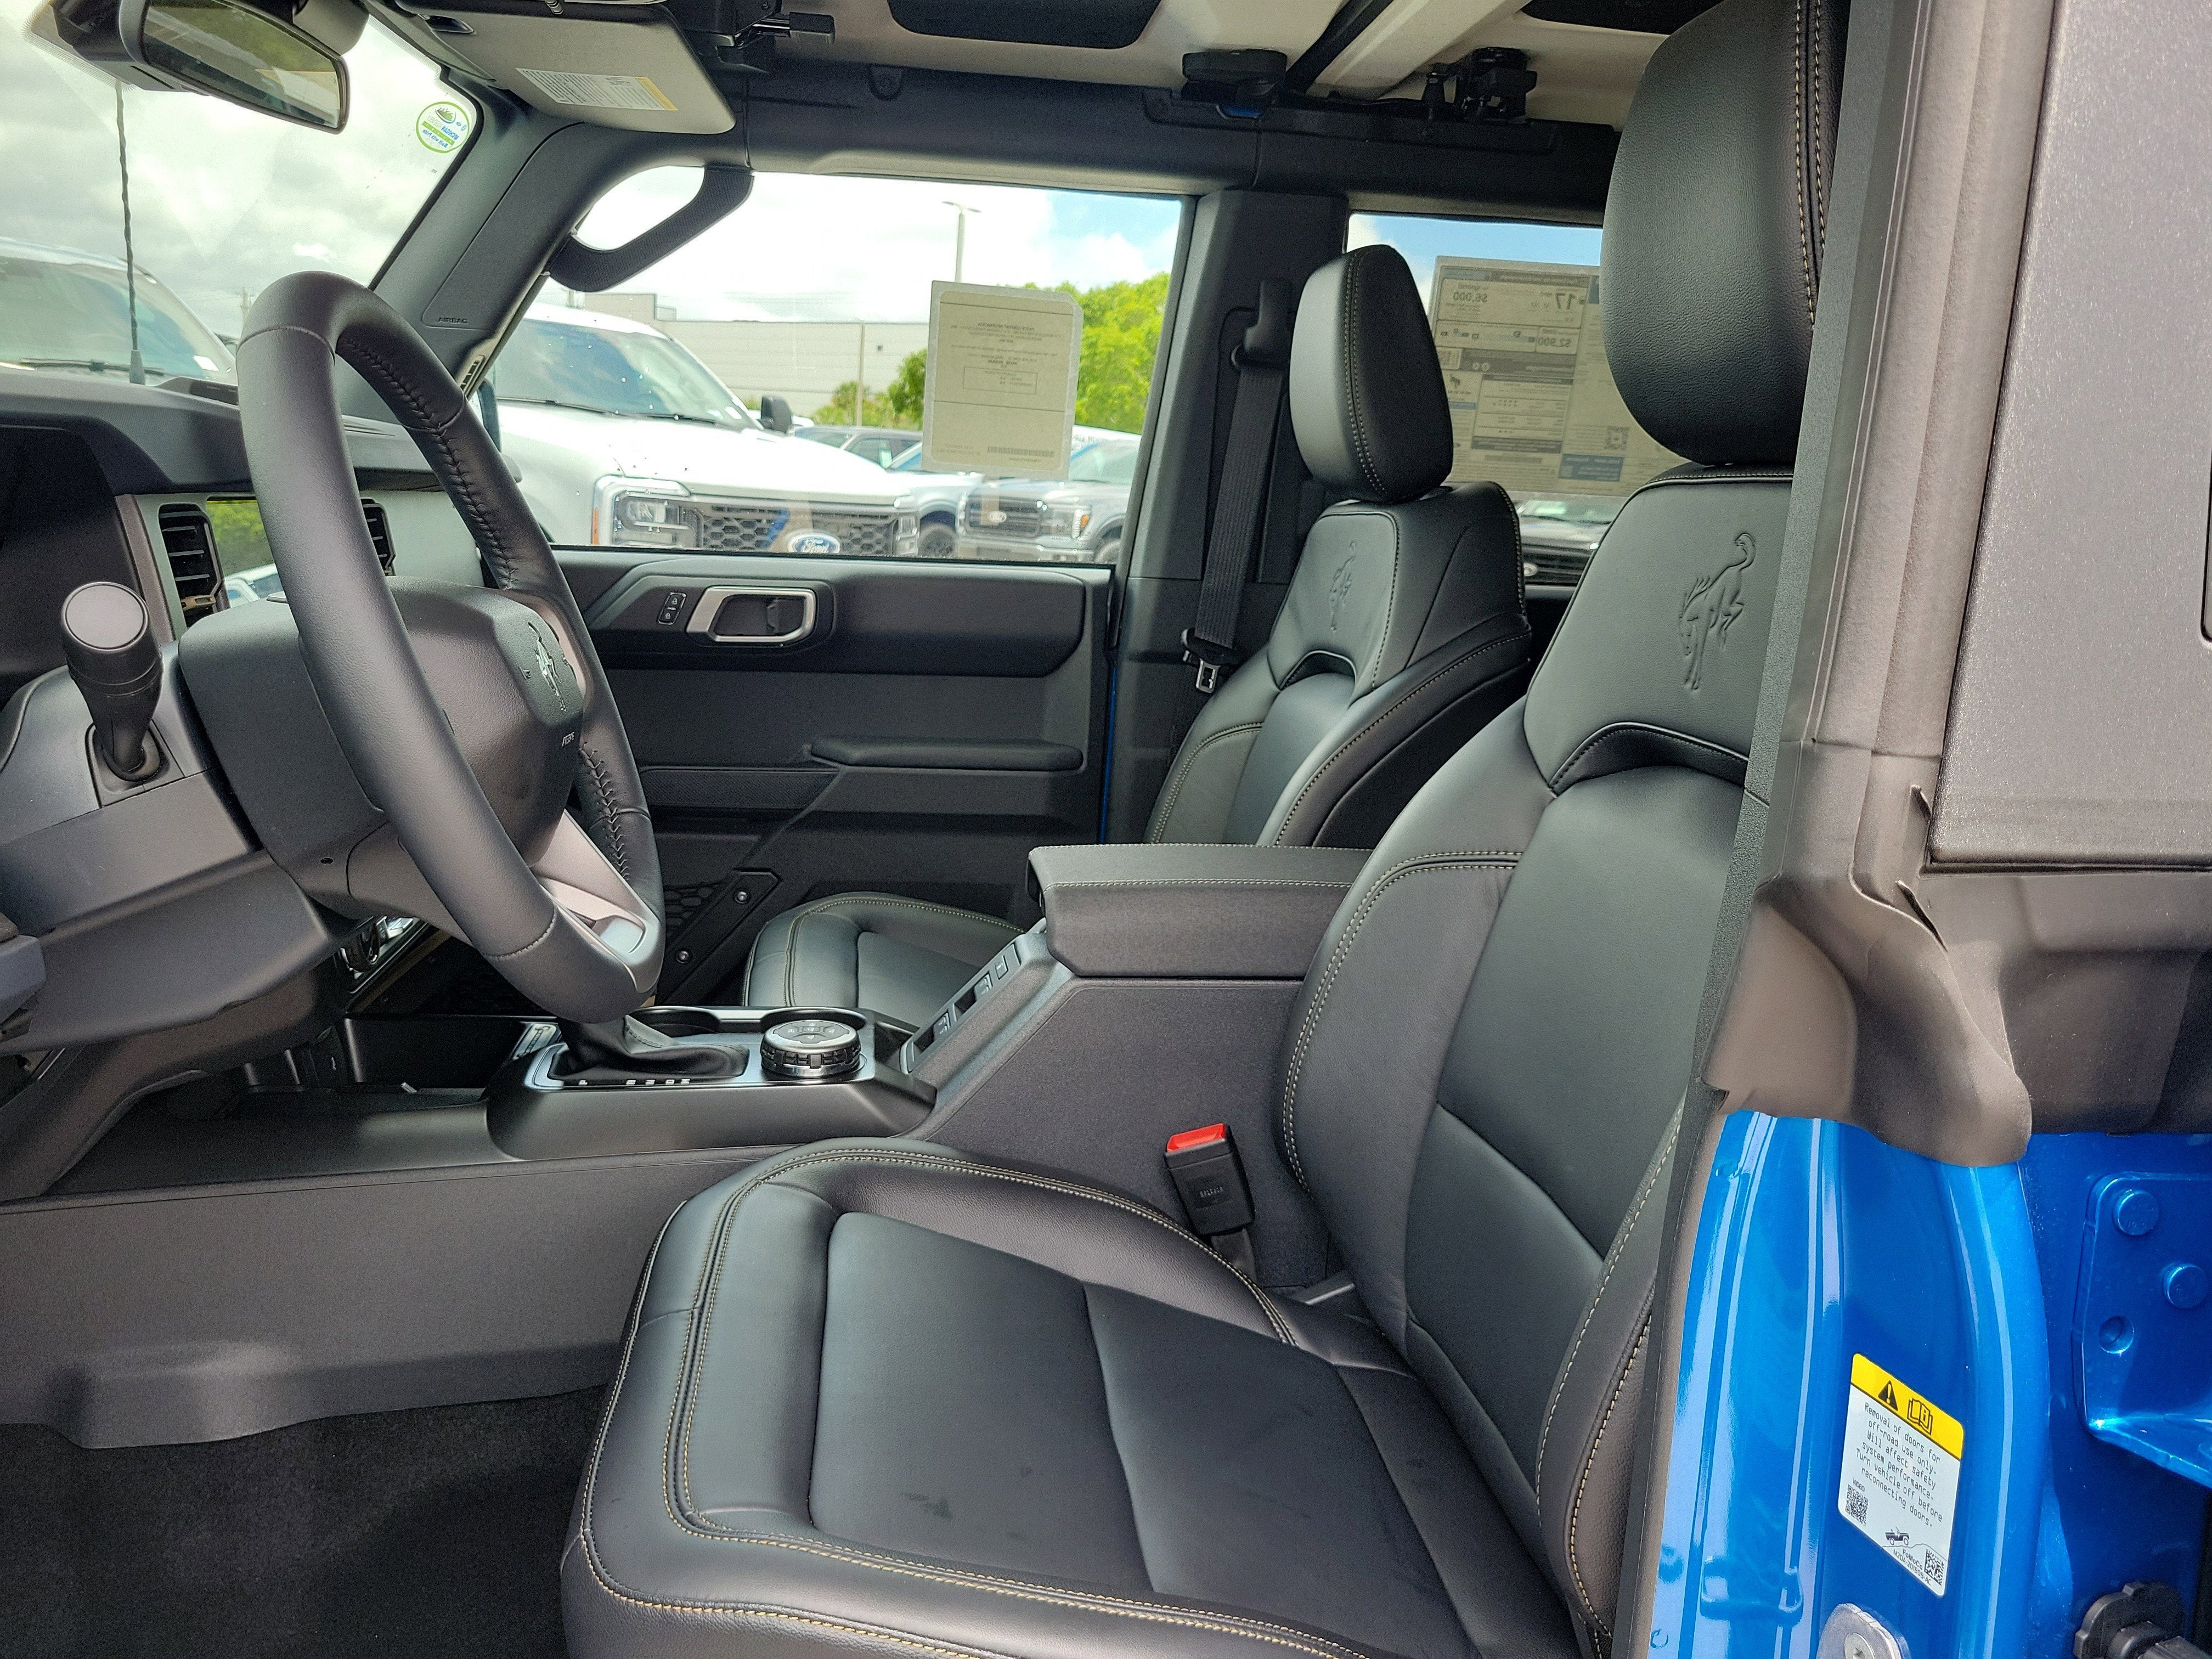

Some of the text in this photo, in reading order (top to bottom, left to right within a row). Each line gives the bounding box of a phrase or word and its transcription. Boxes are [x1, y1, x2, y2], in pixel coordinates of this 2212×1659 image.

[1865, 1402, 1940, 1464] Removal of doors for
[1867, 1430, 1936, 1490] Will affect safety
[1869, 1420, 1937, 1475] off-road use only.
[1852, 1478, 1865, 1492] VIDEO
[1857, 1448, 1943, 1522] Turn vehicle off before
[1861, 1468, 1932, 1527] reconnecting doors.
[1862, 1442, 1933, 1500] system performance.
[1903, 1548, 1923, 1570] FoMoCo
